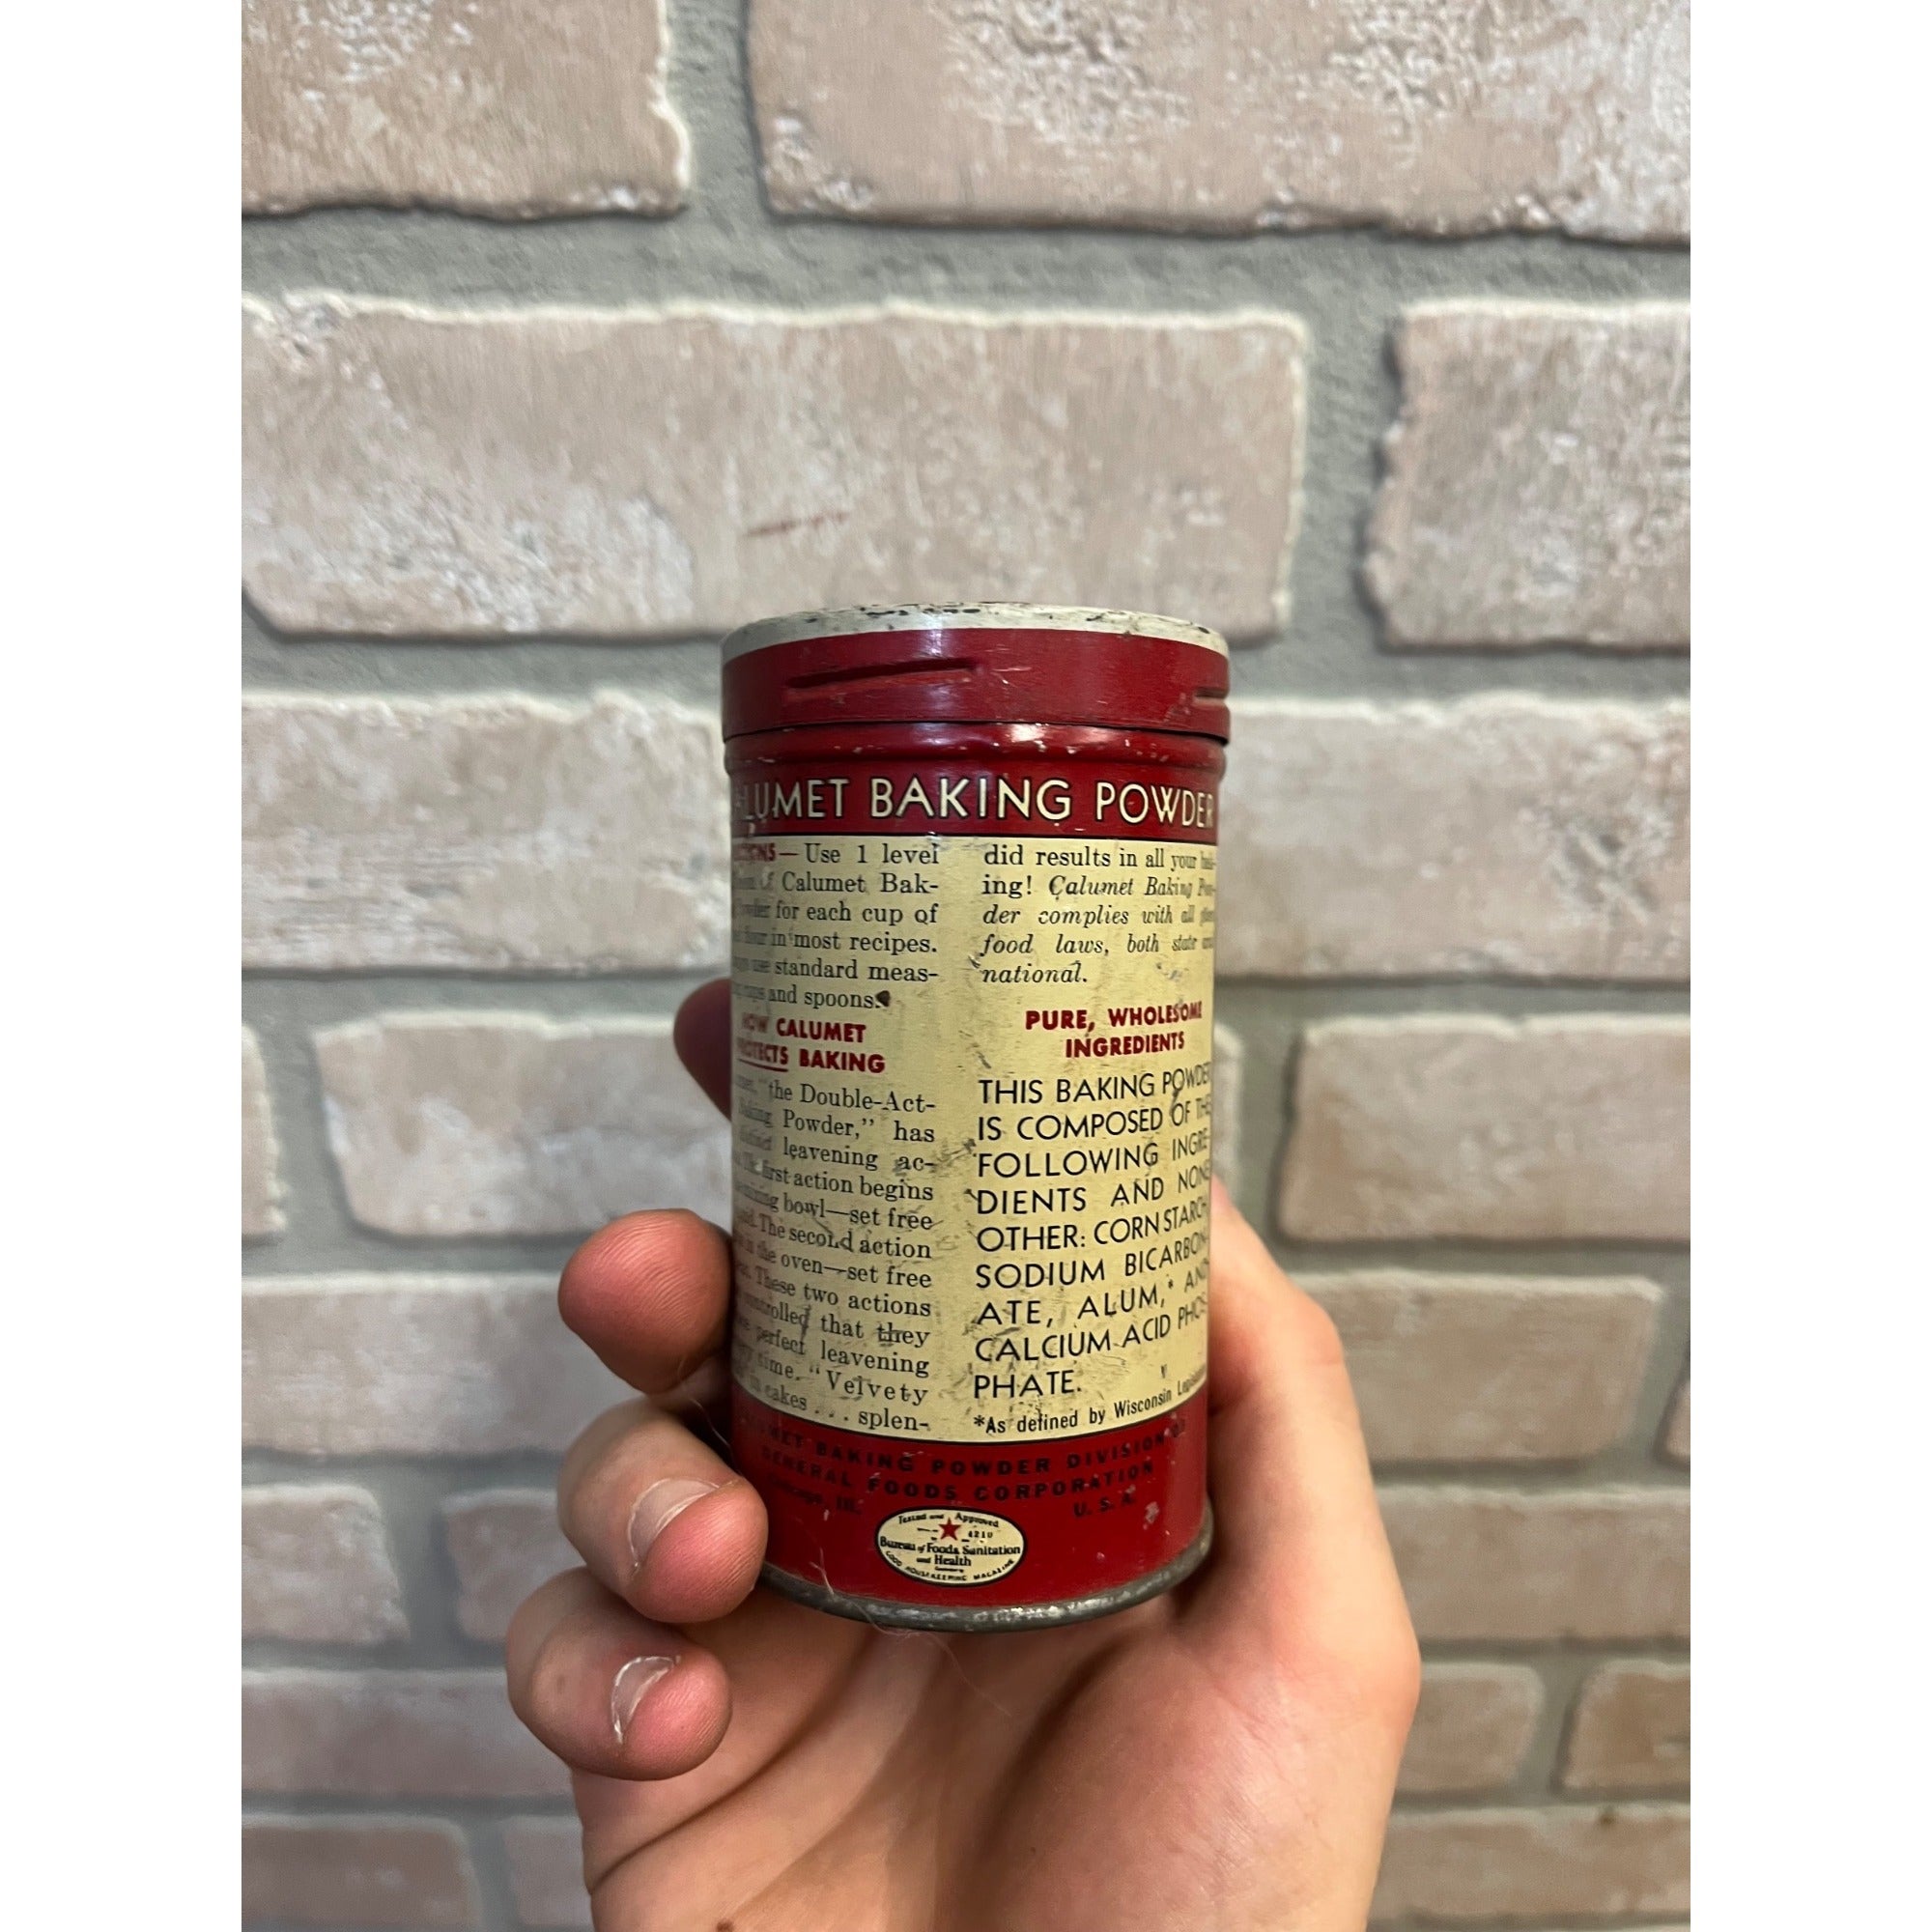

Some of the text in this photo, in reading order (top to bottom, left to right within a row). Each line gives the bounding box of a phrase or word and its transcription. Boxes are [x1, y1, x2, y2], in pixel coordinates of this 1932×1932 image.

[870, 776, 1071, 821] BAKING
[1095, 781, 1214, 828] POWDER
[857, 845, 867, 864] 1
[882, 843, 939, 865] level
[984, 844, 1023, 866] did
[1036, 845, 1111, 867] results
[1119, 848, 1137, 867] in
[1145, 848, 1165, 868] all
[781, 870, 866, 893] Calumet
[880, 872, 939, 894] Bak-
[981, 874, 1032, 899] ing!
[1049, 874, 1134, 896] Calumet
[1144, 876, 1193, 899] Baking
[776, 900, 800, 920] for
[807, 901, 851, 921] each
[862, 906, 903, 926] cup
[914, 903, 939, 923] of
[983, 904, 1021, 924] der
[1038, 904, 1129, 928] complies
[1142, 904, 1174, 924] with
[793, 931, 841, 951] most
[849, 931, 938, 954] recipes.
[980, 933, 1034, 957] food
[1056, 933, 1110, 957] laws,
[1126, 933, 1159, 953] both
[774, 958, 858, 980] standard
[867, 964, 939, 982] meas-
[981, 961, 1088, 983] national.
[769, 983, 797, 1004] and
[776, 1017, 867, 1043] CALUMET
[1025, 1001, 1203, 1033] PURE, WHOLESOME
[1065, 1031, 1185, 1059] INGREDIENTS
[799, 1048, 886, 1074] BAKING
[979, 1079, 1043, 1105] THIS
[1056, 1072, 1155, 1103] BAKING
[894, 1120, 935, 1143] has
[979, 1116, 1002, 1141] IS
[1017, 1107, 1163, 1141] COMPOSED
[1171, 1100, 1191, 1126] OF
[782, 1136, 878, 1172] leavening
[979, 1142, 1159, 1179] FOLLOWING
[794, 1171, 853, 1194] action
[859, 1175, 933, 1202] begins
[977, 1186, 1087, 1215] DIENTS
[1111, 1177, 1164, 1208] AND
[889, 1207, 934, 1230] free
[758, 1212, 785, 1238] The
[860, 1236, 932, 1260] action
[977, 1223, 1086, 1253] OTHER:
[886, 1265, 932, 1289] free
[976, 1258, 1105, 1290] SODIUM
[804, 1283, 838, 1305] two
[848, 1293, 931, 1318] actions
[977, 1300, 1054, 1328] ATE,
[821, 1313, 864, 1339] that
[877, 1321, 931, 1349] they
[975, 1329, 1111, 1362] CALCIUM
[1122, 1314, 1171, 1349] ACID
[821, 1340, 929, 1378] leavening
[974, 1369, 1082, 1399] PHATE.
[858, 1407, 929, 1432] splen-
[1017, 1410, 1078, 1433] defined
[1090, 1407, 1106, 1425] by
[1114, 1388, 1172, 1418] Wisconsin
[816, 1440, 914, 1472] BAKING
[931, 1457, 1050, 1477] POWDER
[1066, 1433, 1165, 1469] DIVISION
[867, 1477, 958, 1500] FOODS
[974, 1460, 1153, 1502] CORPORATION
[954, 1512, 1000, 1528] Approved
[879, 1535, 916, 1551] Bureau
[962, 1544, 1021, 1556] Sanitation
[934, 1554, 972, 1567] Health
